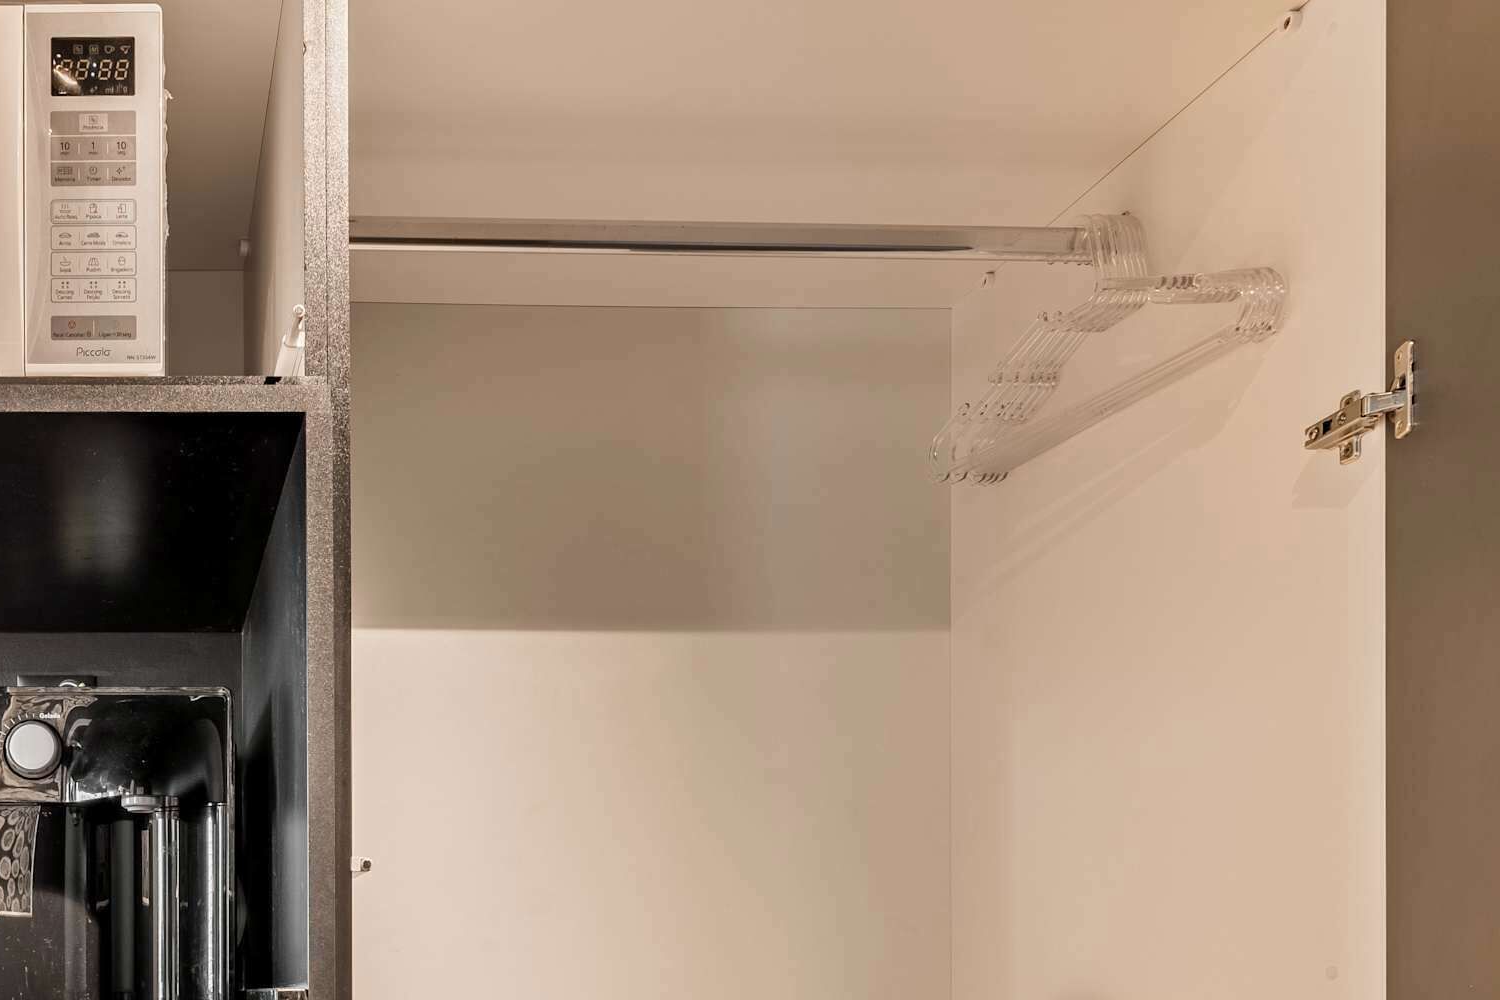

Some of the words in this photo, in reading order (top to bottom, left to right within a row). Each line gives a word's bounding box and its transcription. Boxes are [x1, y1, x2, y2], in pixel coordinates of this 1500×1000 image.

[60, 141, 70, 151] 10
[116, 141, 127, 151] 10
[75, 346, 113, 358] Piccolo
